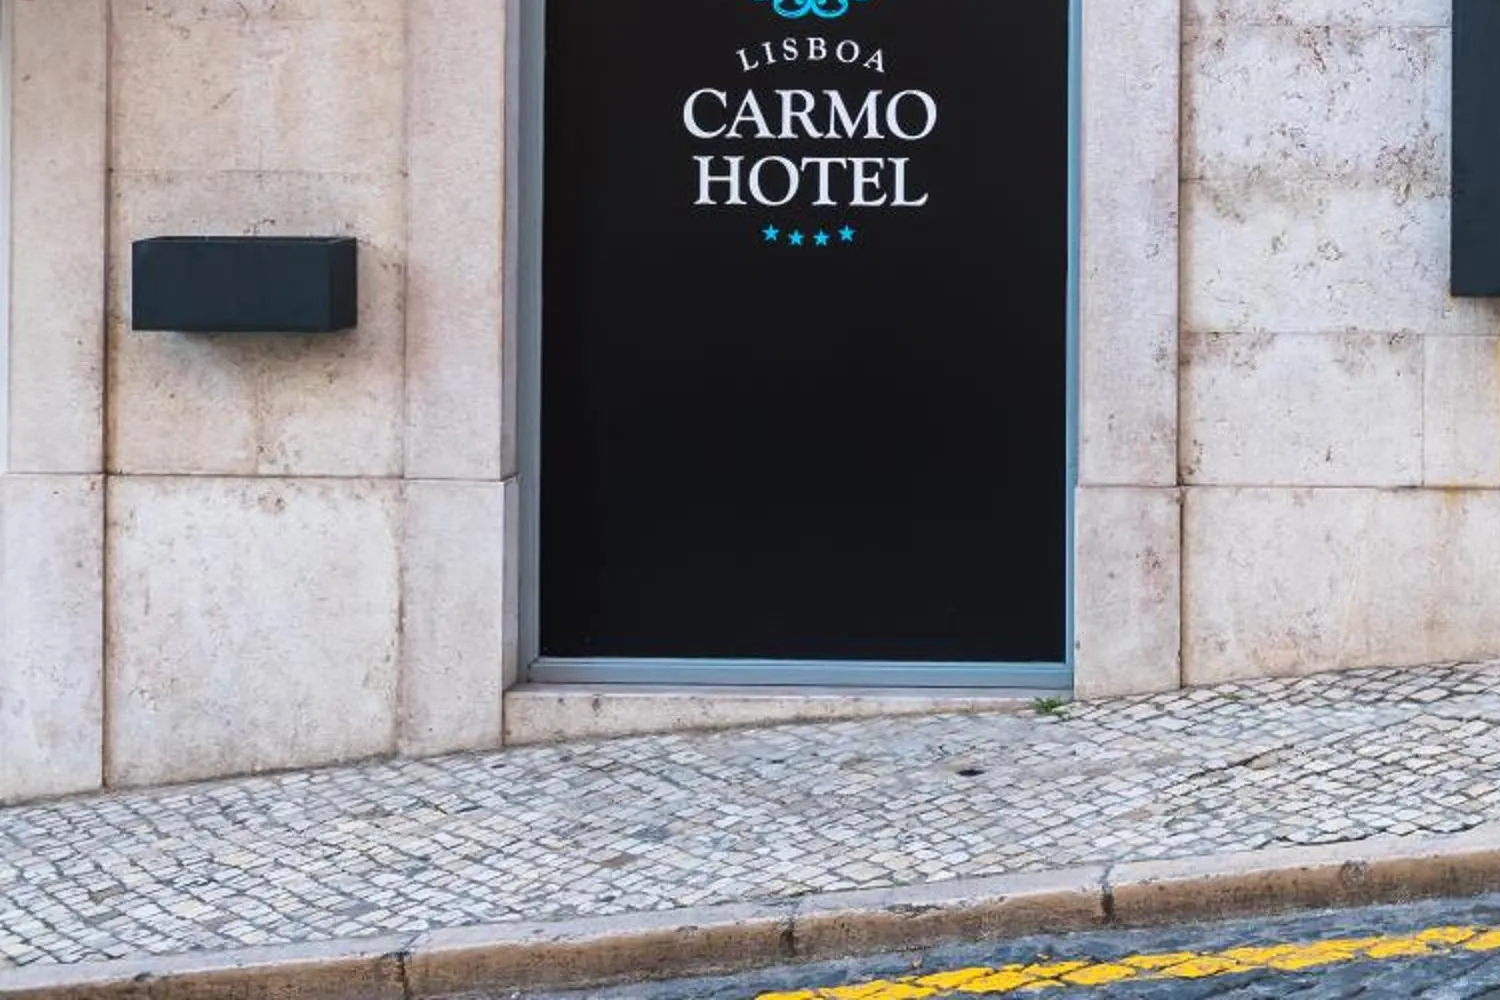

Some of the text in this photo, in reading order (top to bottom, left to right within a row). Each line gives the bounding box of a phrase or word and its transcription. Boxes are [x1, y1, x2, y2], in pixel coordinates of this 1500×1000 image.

[735, 36, 885, 73] LISBOA
[682, 87, 937, 141] CARMO
[692, 155, 929, 207] HOTEL
